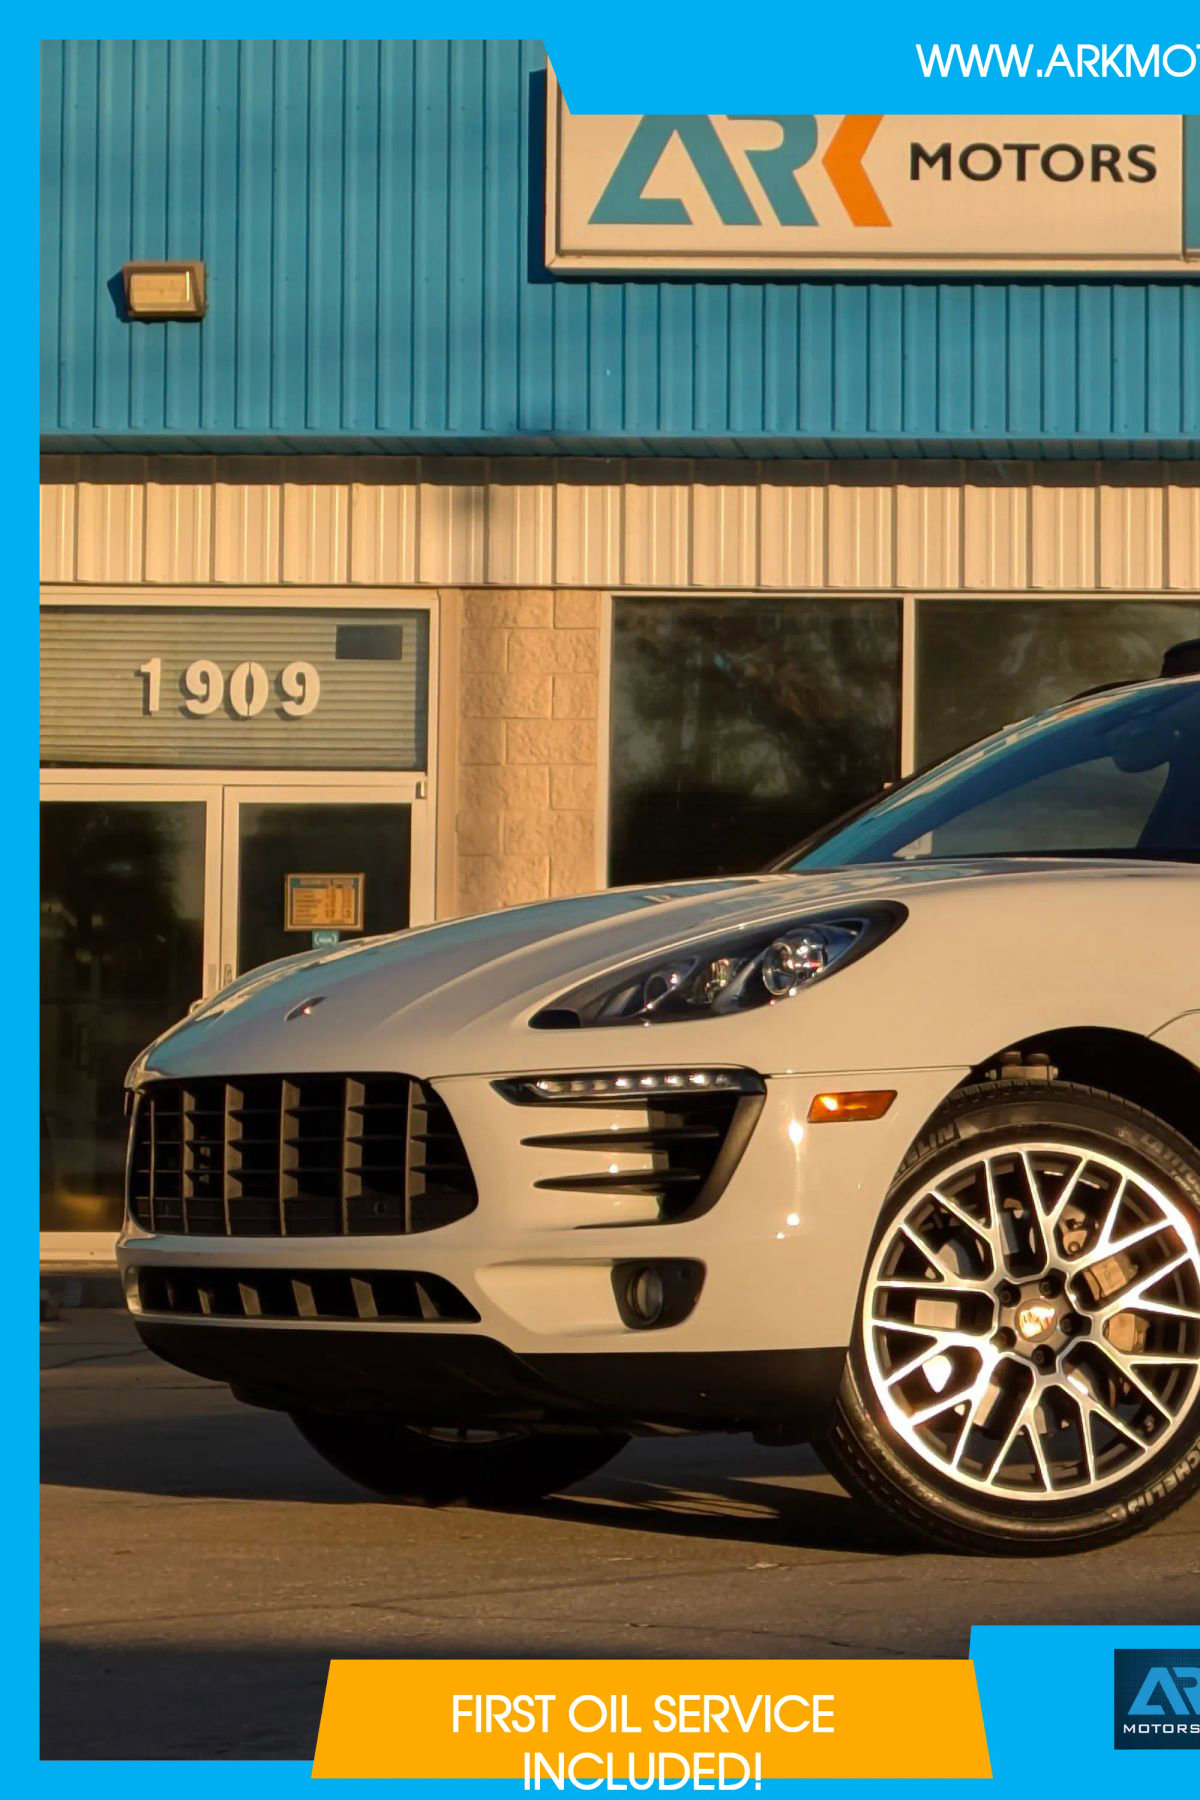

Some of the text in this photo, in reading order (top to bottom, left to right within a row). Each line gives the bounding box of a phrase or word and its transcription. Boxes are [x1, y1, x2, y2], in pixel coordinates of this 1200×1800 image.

[588, 114, 1157, 227] ARK MOTORS
[140, 657, 321, 717] 1909
